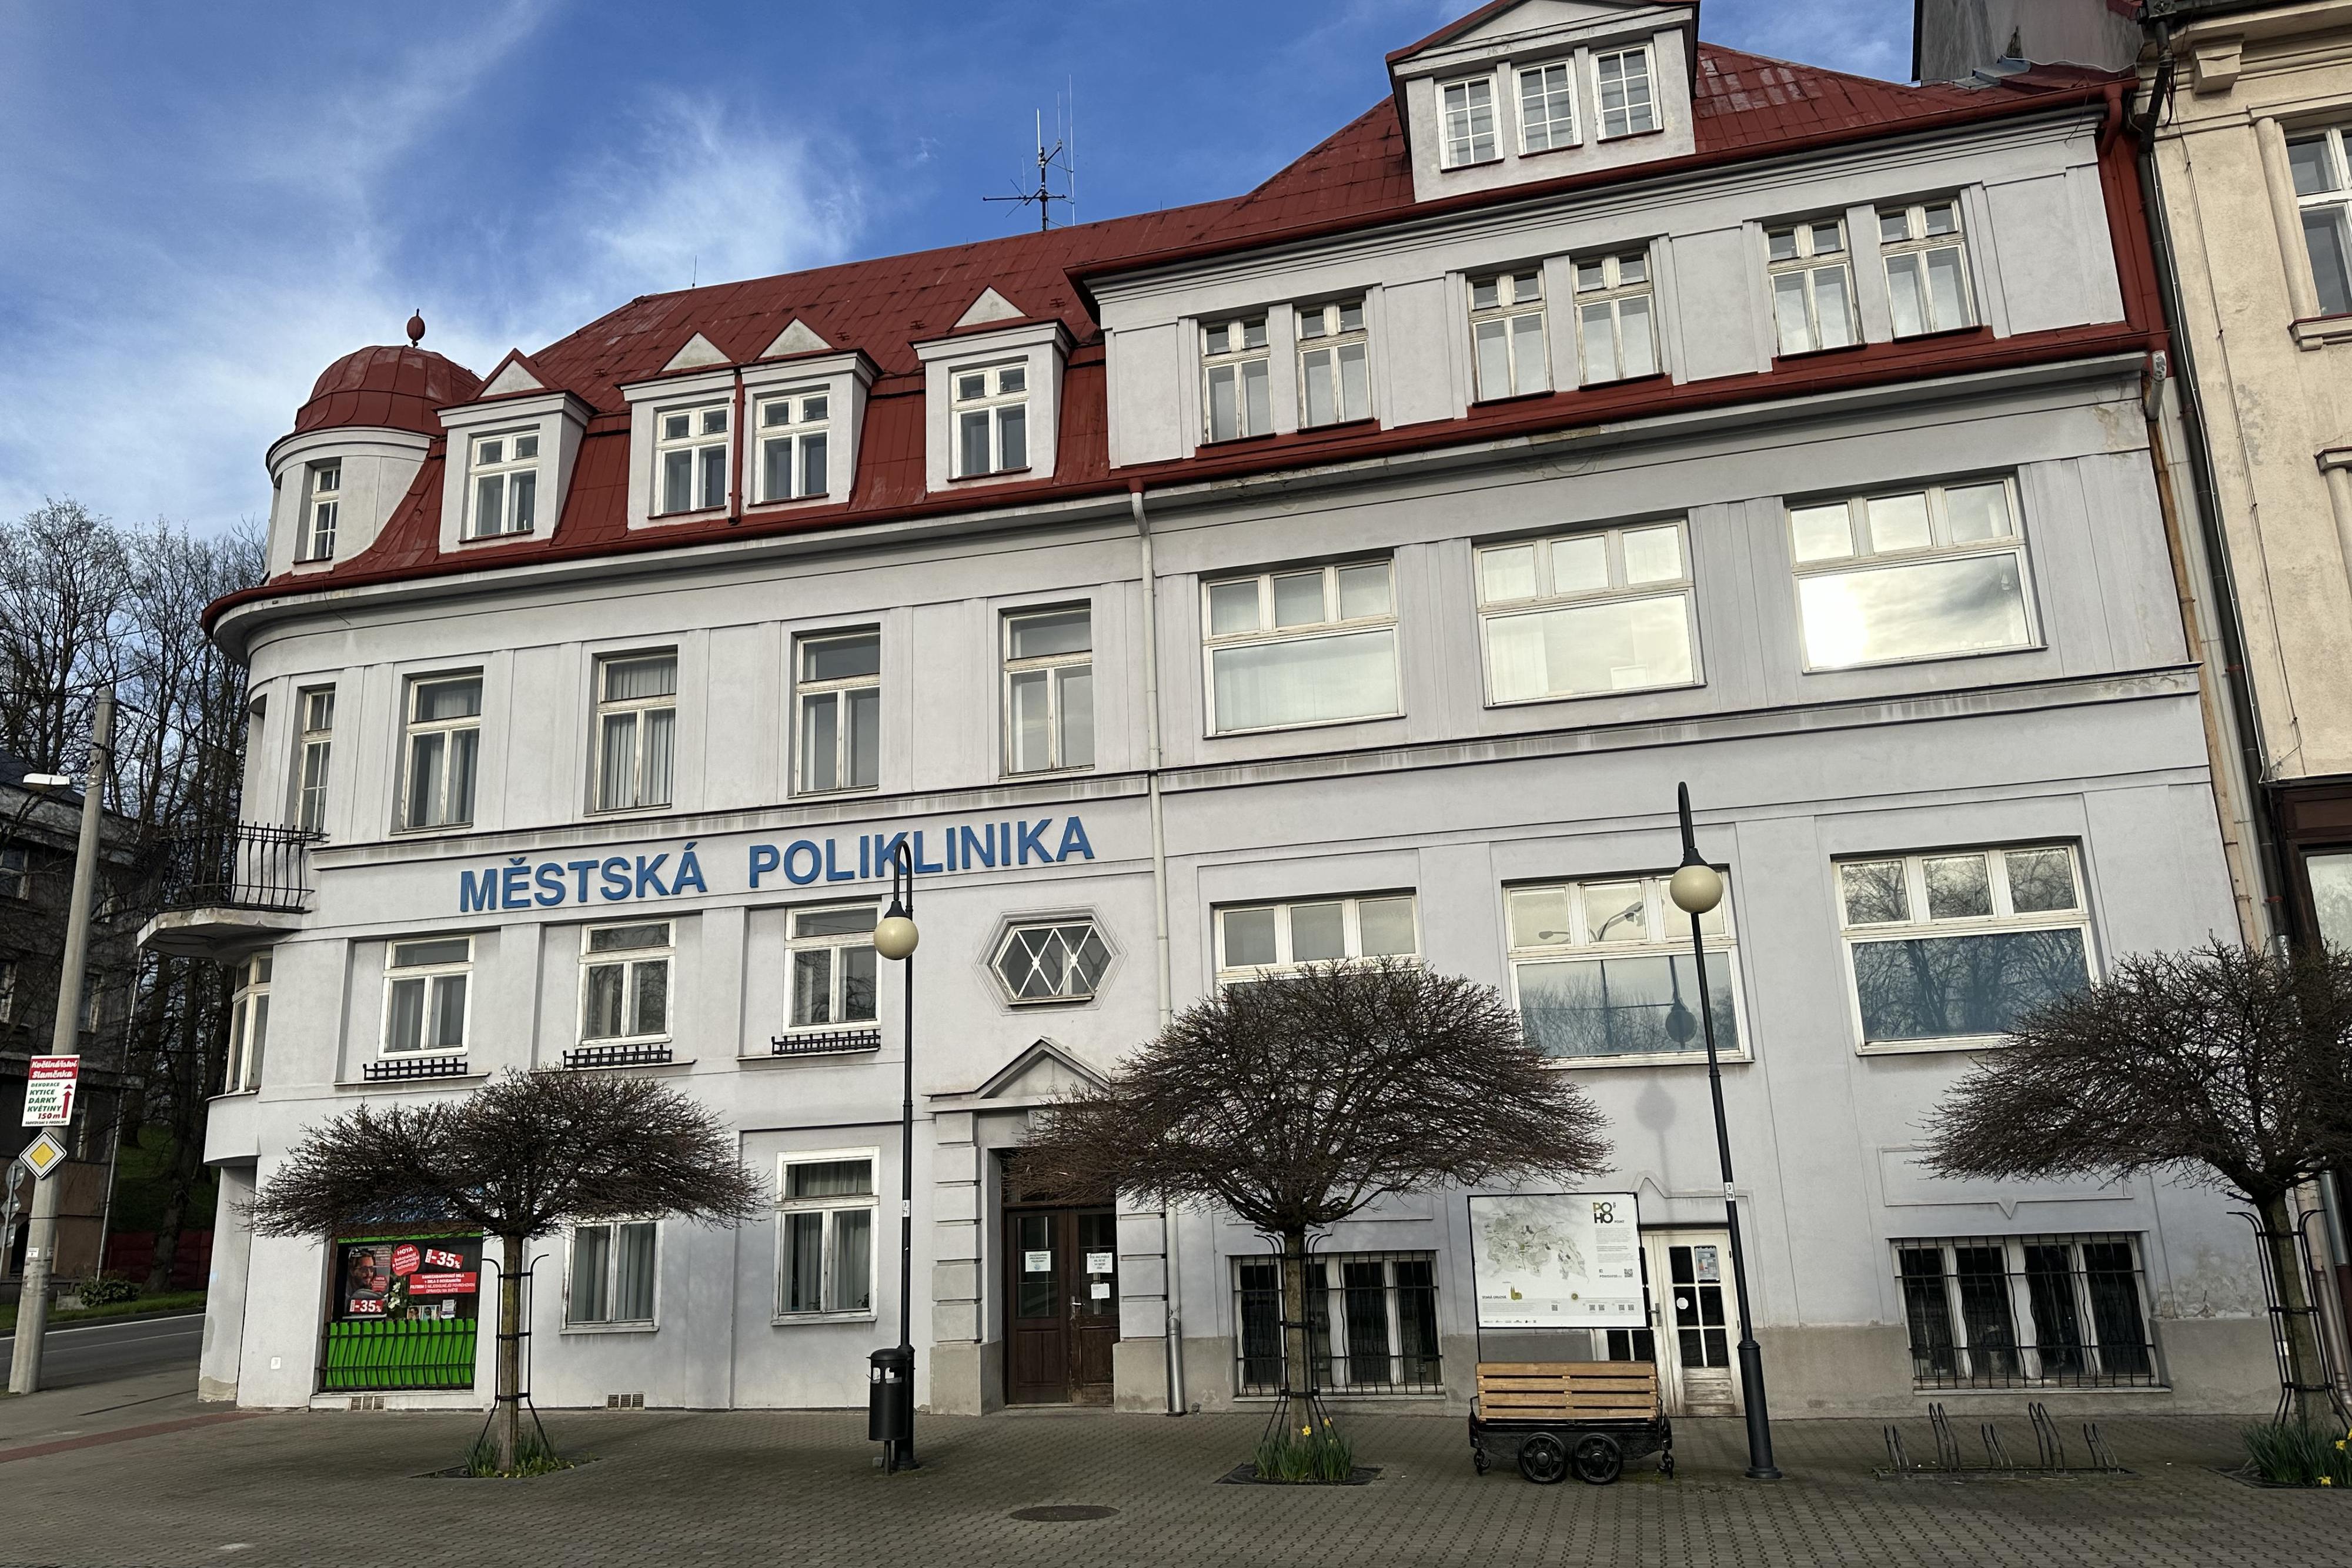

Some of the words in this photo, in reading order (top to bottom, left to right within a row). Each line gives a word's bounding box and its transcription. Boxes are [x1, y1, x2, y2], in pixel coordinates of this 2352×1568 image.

[460, 841, 706, 912] MĚSTSKÁ
[750, 817, 1094, 888] POLIKLINIKA
[397, 1246, 413, 1256] HOYA
[355, 1299, 382, 1312] -35%
